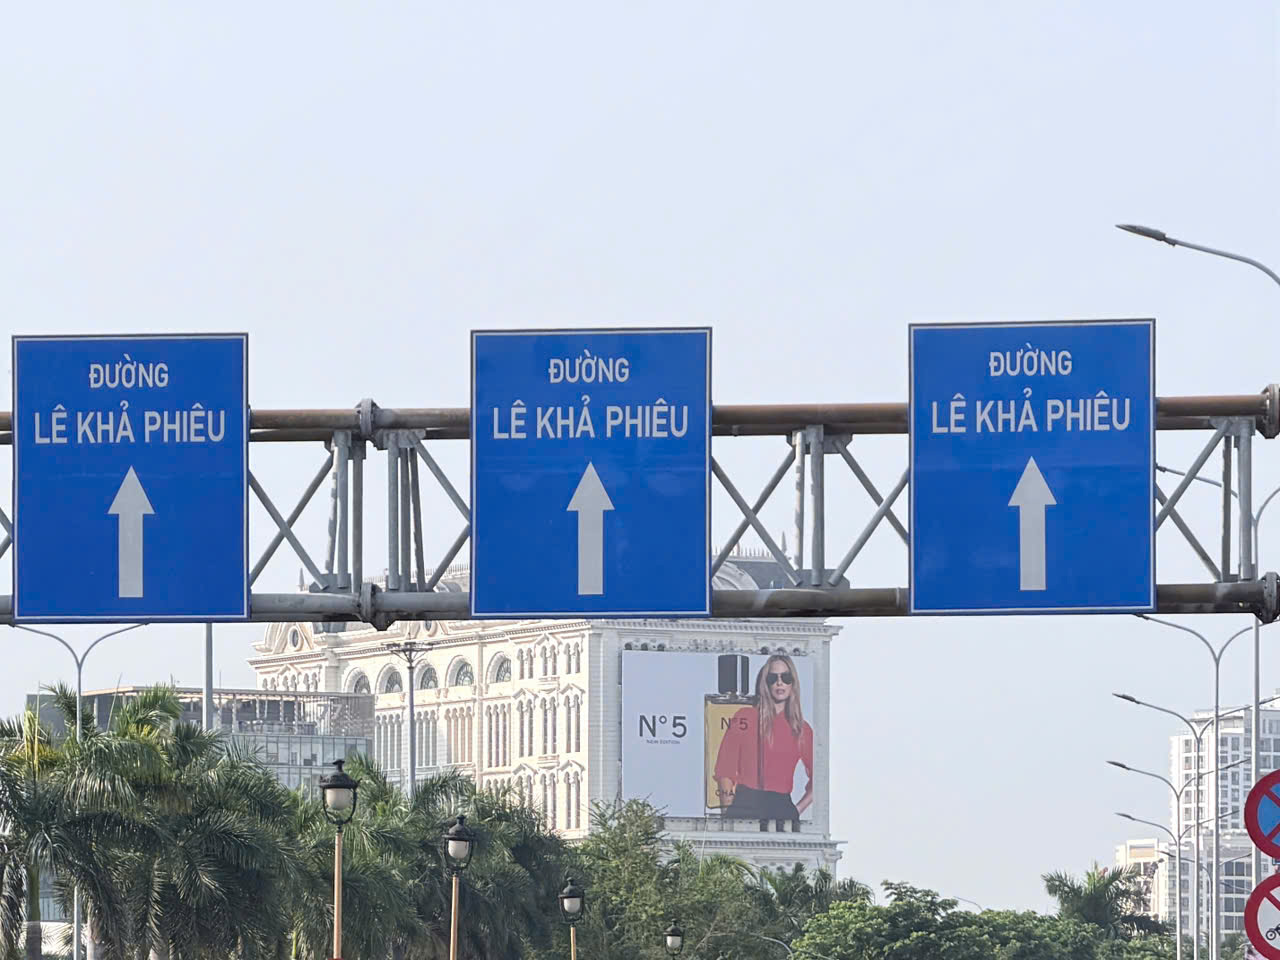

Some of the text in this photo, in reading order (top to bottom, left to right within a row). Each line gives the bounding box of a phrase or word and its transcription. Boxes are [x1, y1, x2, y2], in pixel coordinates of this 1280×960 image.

[89, 353, 169, 388] ĐƯỜNG
[548, 349, 630, 384] ĐƯỜNG
[989, 342, 1072, 377] ĐƯỜNG
[34, 400, 225, 444] LÊ KHẢ PHIÊU
[493, 395, 688, 439] LÊ KHẢ PHIÊU
[931, 387, 1130, 433] LÊ KHẢ PHIÊU
